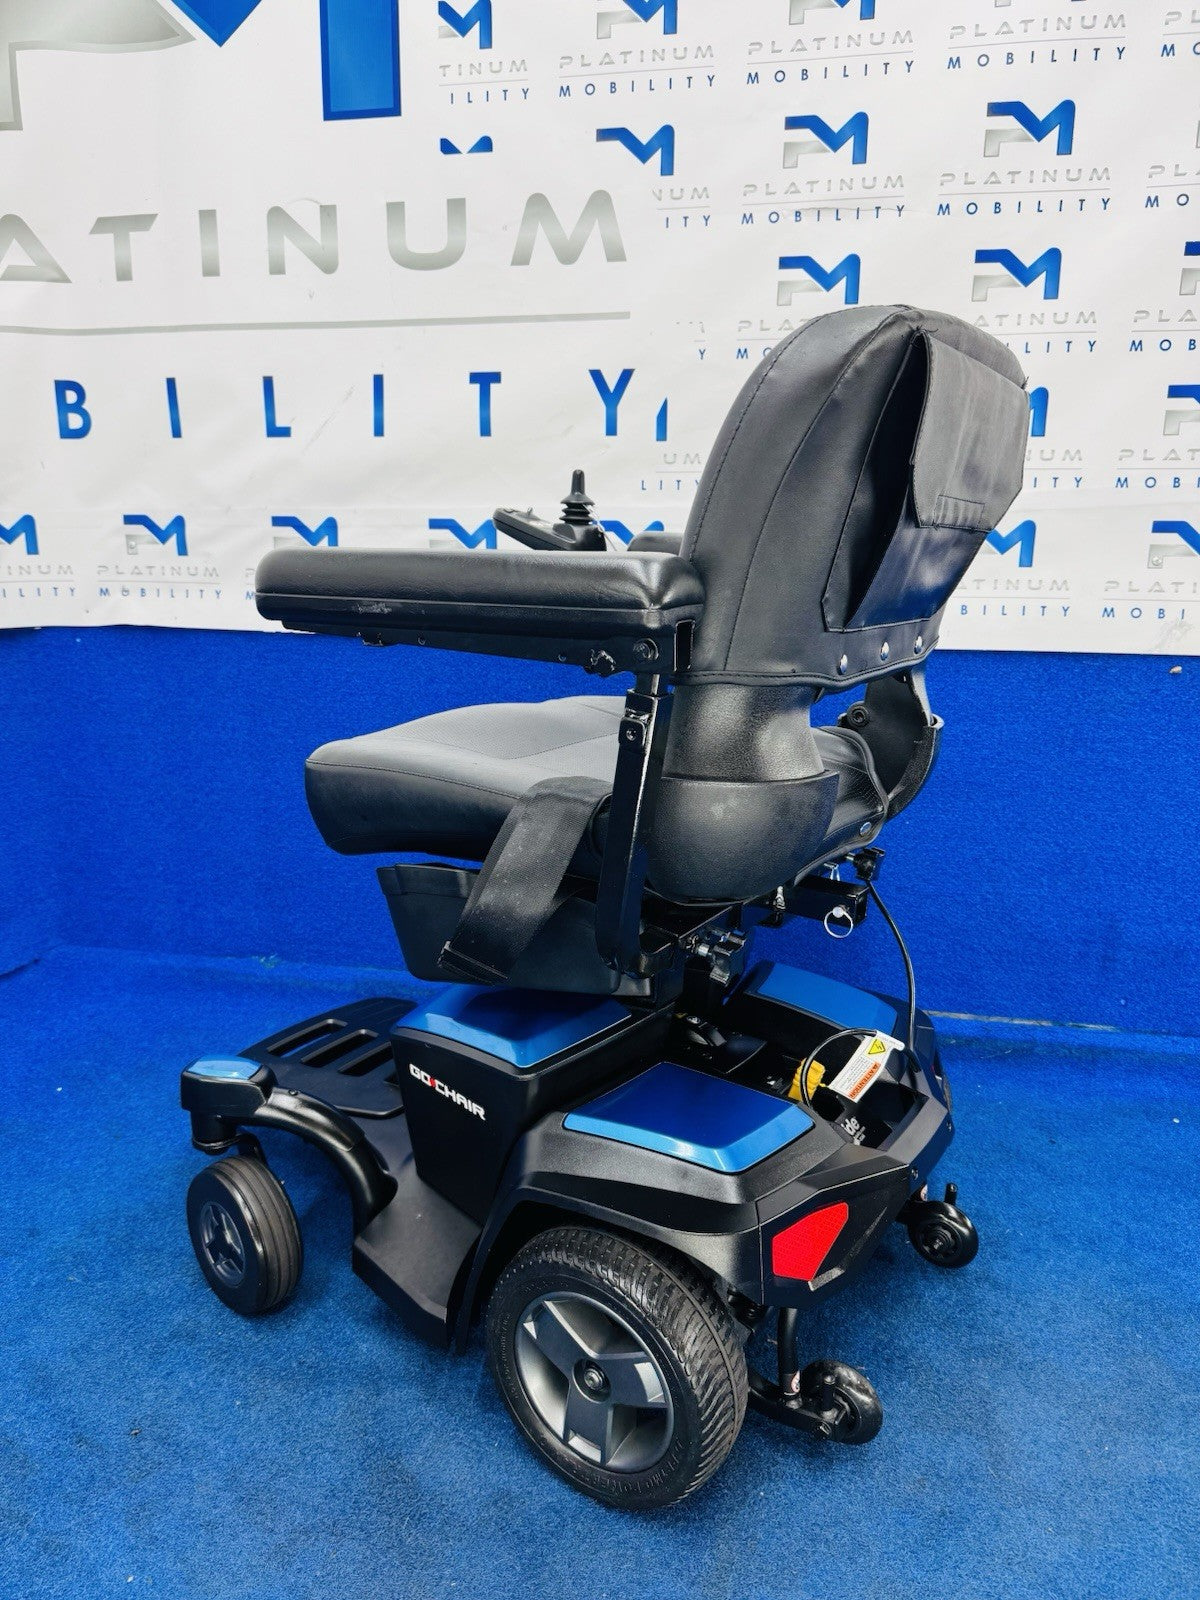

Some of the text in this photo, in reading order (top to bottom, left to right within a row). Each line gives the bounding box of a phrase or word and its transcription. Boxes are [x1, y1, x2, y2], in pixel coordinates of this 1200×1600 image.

[949, 13, 1127, 40] PLATINUM
[747, 30, 914, 56] PLATINUM
[559, 45, 715, 70] PLATINUM
[947, 46, 1126, 70] MOBILITY
[438, 59, 528, 77] TINUM
[746, 60, 915, 85] MOBILITY
[558, 74, 716, 98] MOBILITY
[450, 87, 530, 105] ILITY
[939, 166, 1111, 187] PLATINUM
[1147, 163, 1200, 179] PL
[742, 174, 905, 197] PLATINUM
[937, 197, 1111, 216] MOBILITY
[1144, 193, 1190, 209] MO
[665, 214, 711, 229] ITY
[741, 204, 905, 225] MOBILITY
[1133, 309, 1198, 323] PLA
[1006, 340, 1097, 354] LITY
[1129, 338, 1197, 352] MOB
[53, 366, 635, 440] BILITY
[1033, 476, 1083, 489] ITY
[97, 564, 220, 578] PLATINUM
[98, 587, 222, 599] MOBILITY
[960, 604, 1070, 618] BILITY
[1101, 606, 1185, 620] MOBI
